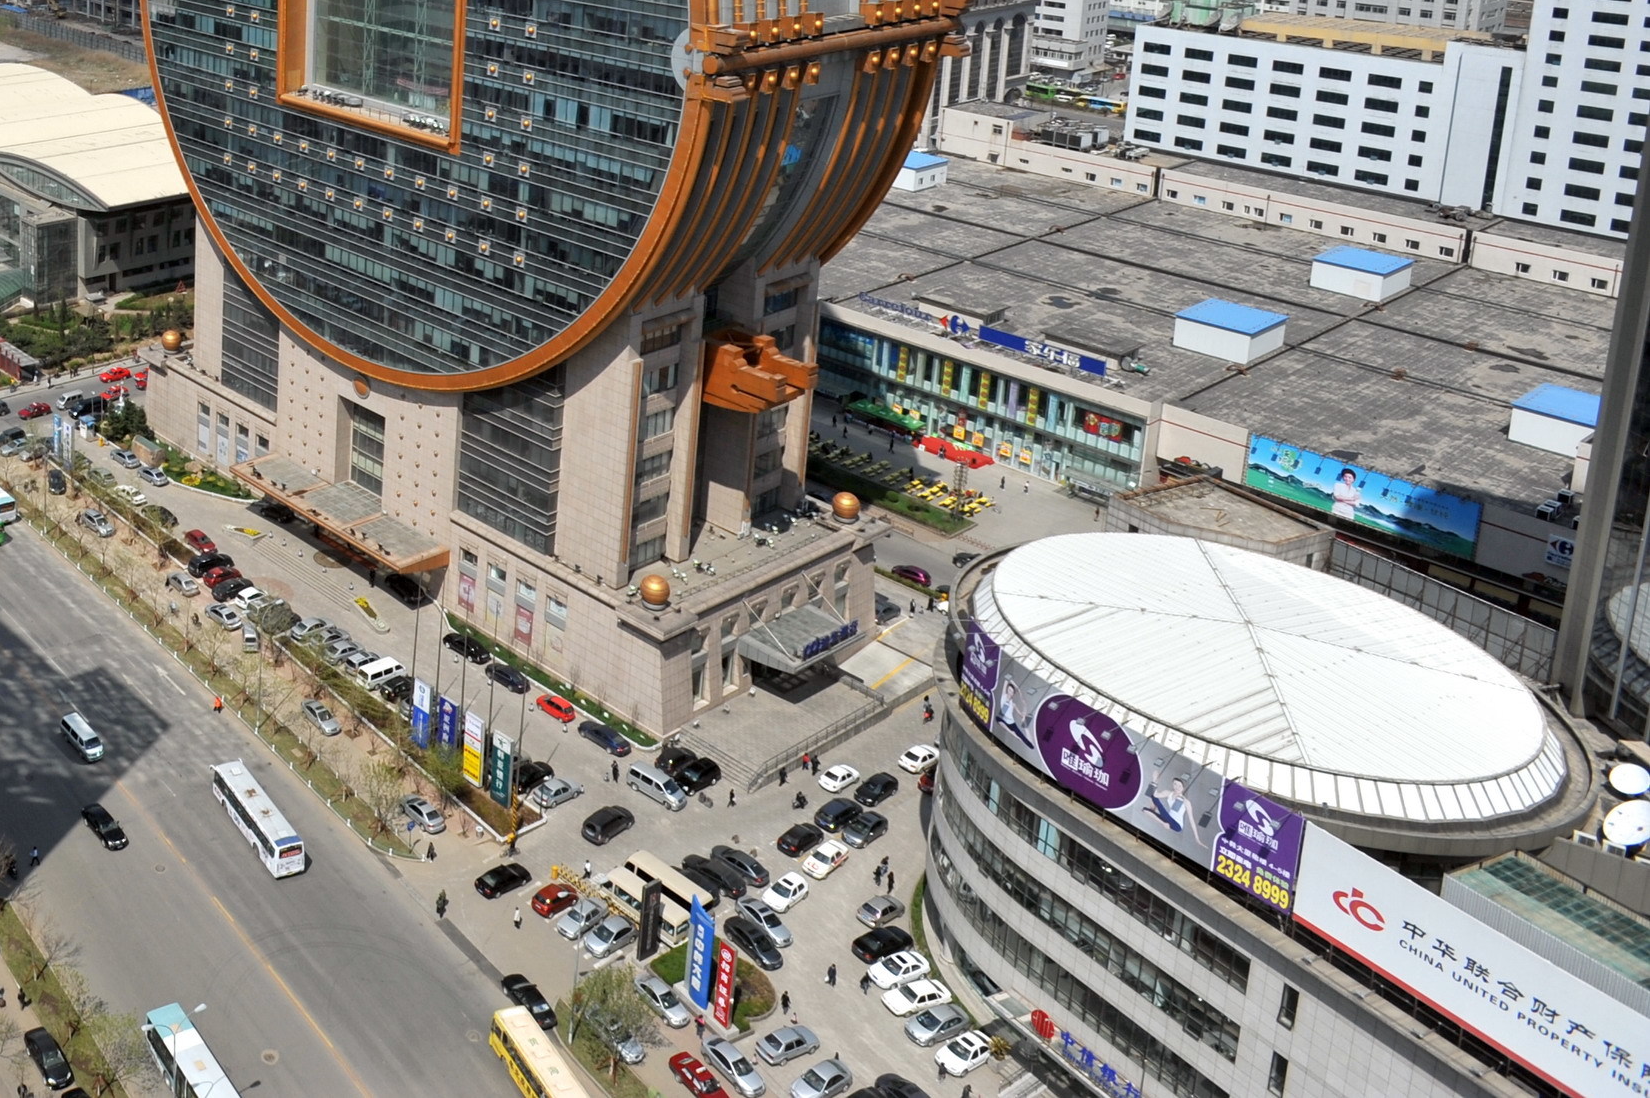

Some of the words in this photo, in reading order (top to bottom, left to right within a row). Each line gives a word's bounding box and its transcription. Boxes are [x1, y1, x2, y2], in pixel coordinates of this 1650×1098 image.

[859, 291, 932, 321] Carrefour
[1024, 340, 1081, 368] 家乐福
[1216, 855, 1251, 888] 2324
[1252, 875, 1290, 909] 8999
[1398, 939, 1444, 973] CHINA
[1452, 971, 1509, 1011] UNITED
[1517, 1012, 1603, 1068] PROPERTY
